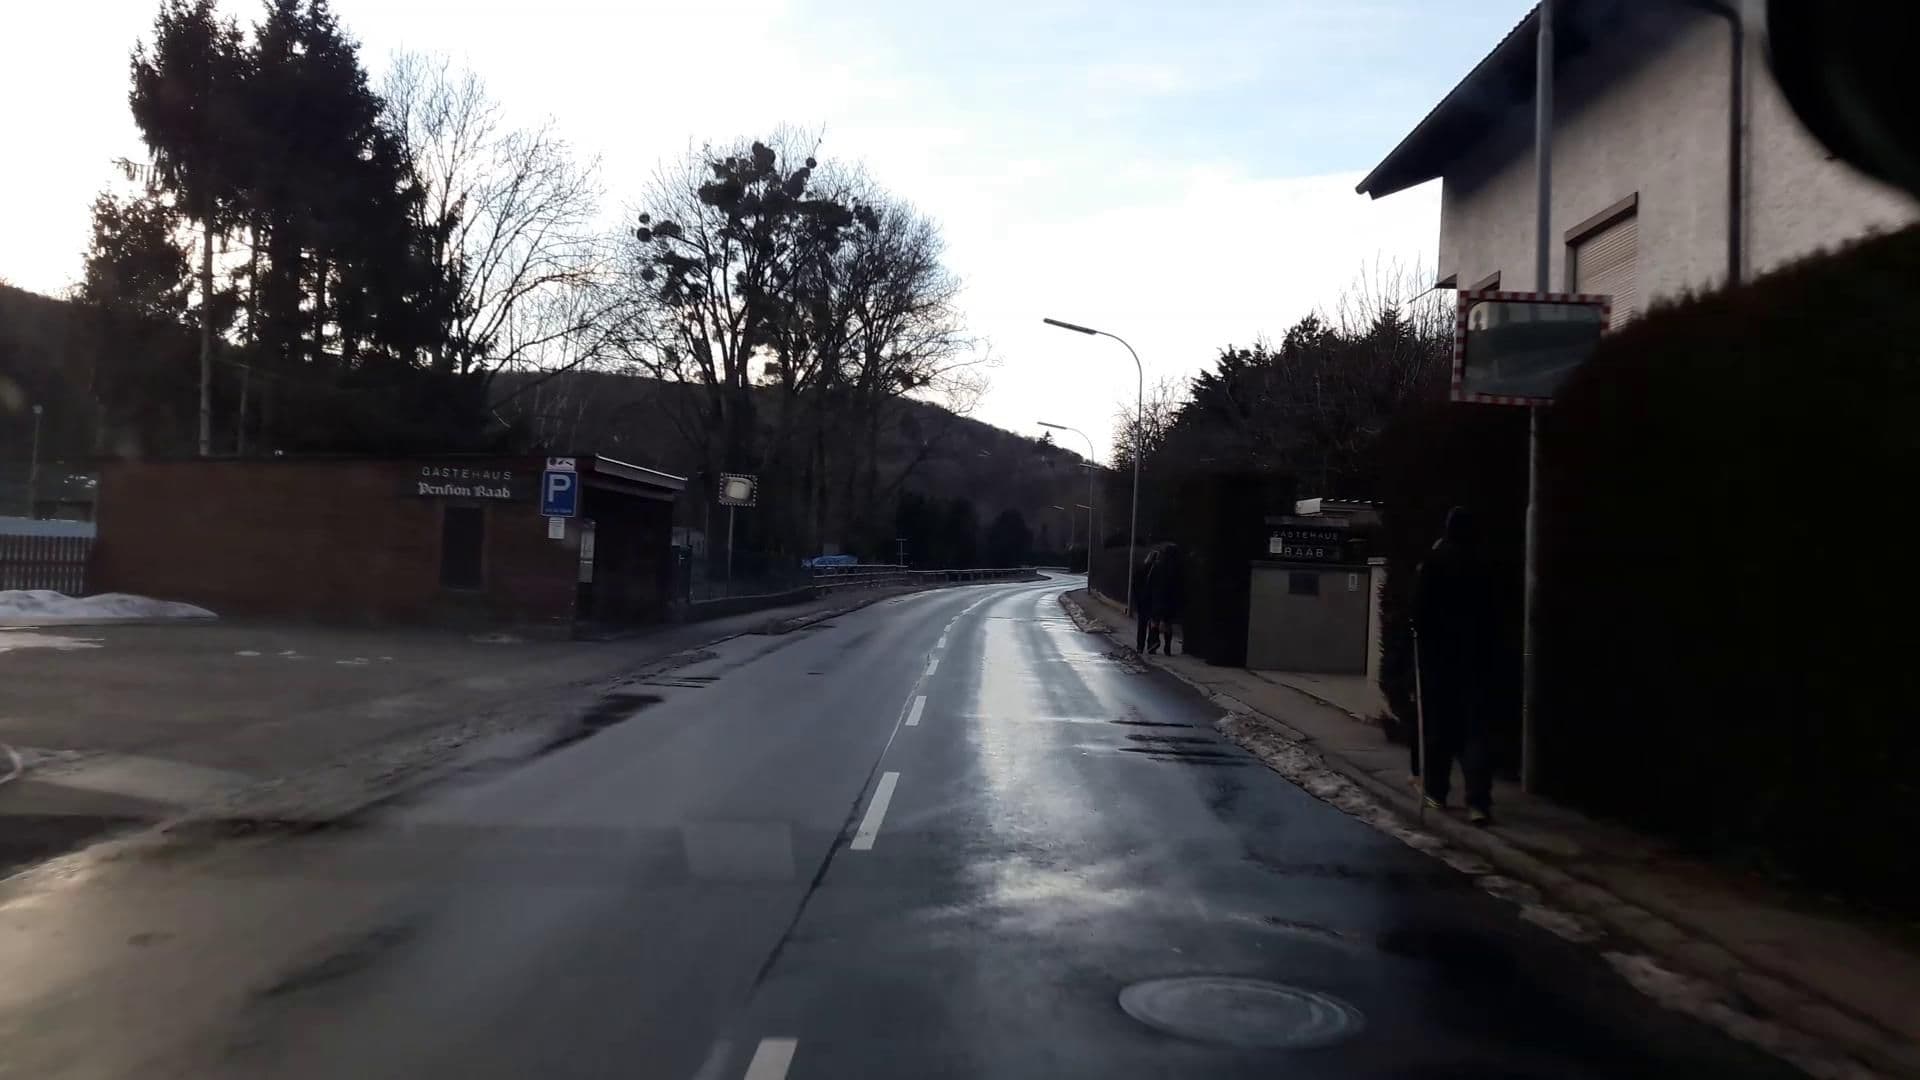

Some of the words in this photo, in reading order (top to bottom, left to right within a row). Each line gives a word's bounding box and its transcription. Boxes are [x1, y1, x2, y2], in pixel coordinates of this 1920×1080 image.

[417, 481, 471, 496] Pension
[472, 484, 511, 498] Raab
[548, 473, 571, 502] P
